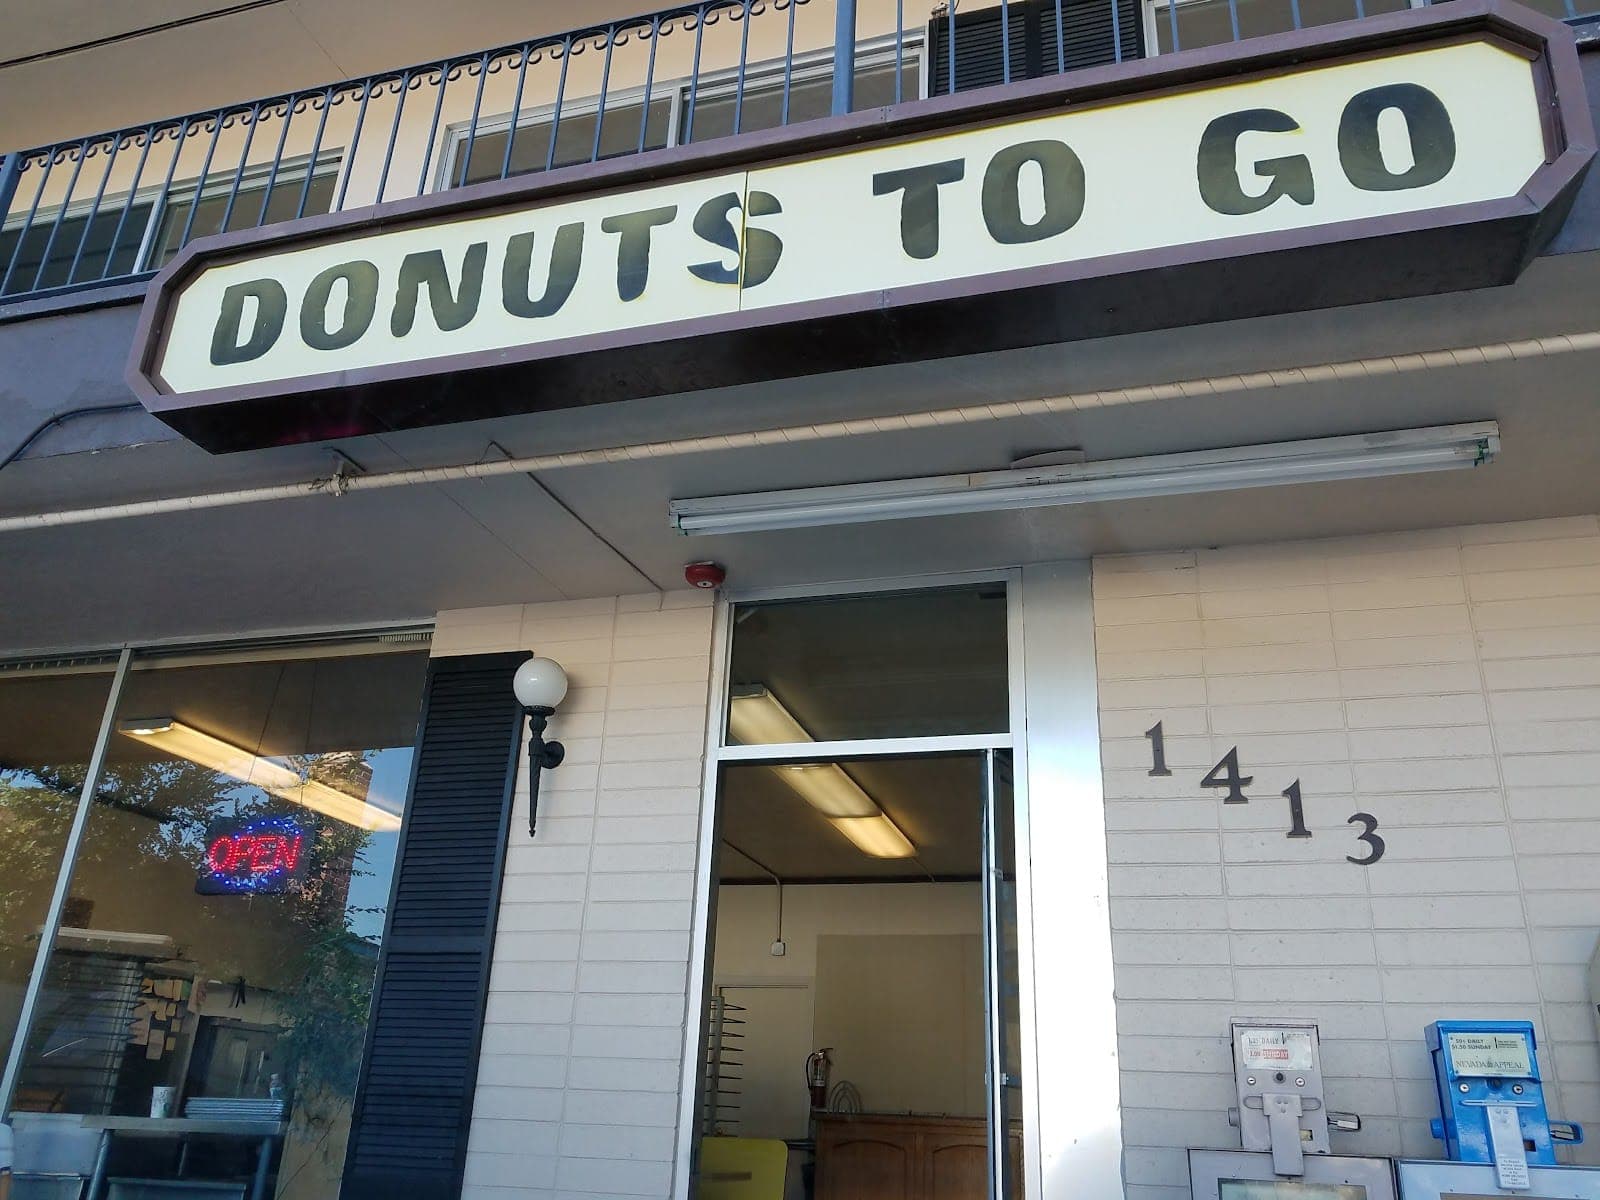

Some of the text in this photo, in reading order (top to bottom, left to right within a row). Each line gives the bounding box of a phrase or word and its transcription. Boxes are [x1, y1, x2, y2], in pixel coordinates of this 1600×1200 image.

[210, 82, 1456, 366] DONUTS TO GO
[1145, 720, 1385, 865] 1413
[209, 835, 302, 871] OPEN
[1262, 1037, 1279, 1045] DAILY
[1456, 1061, 1525, 1069] NEVADA APPEAL
